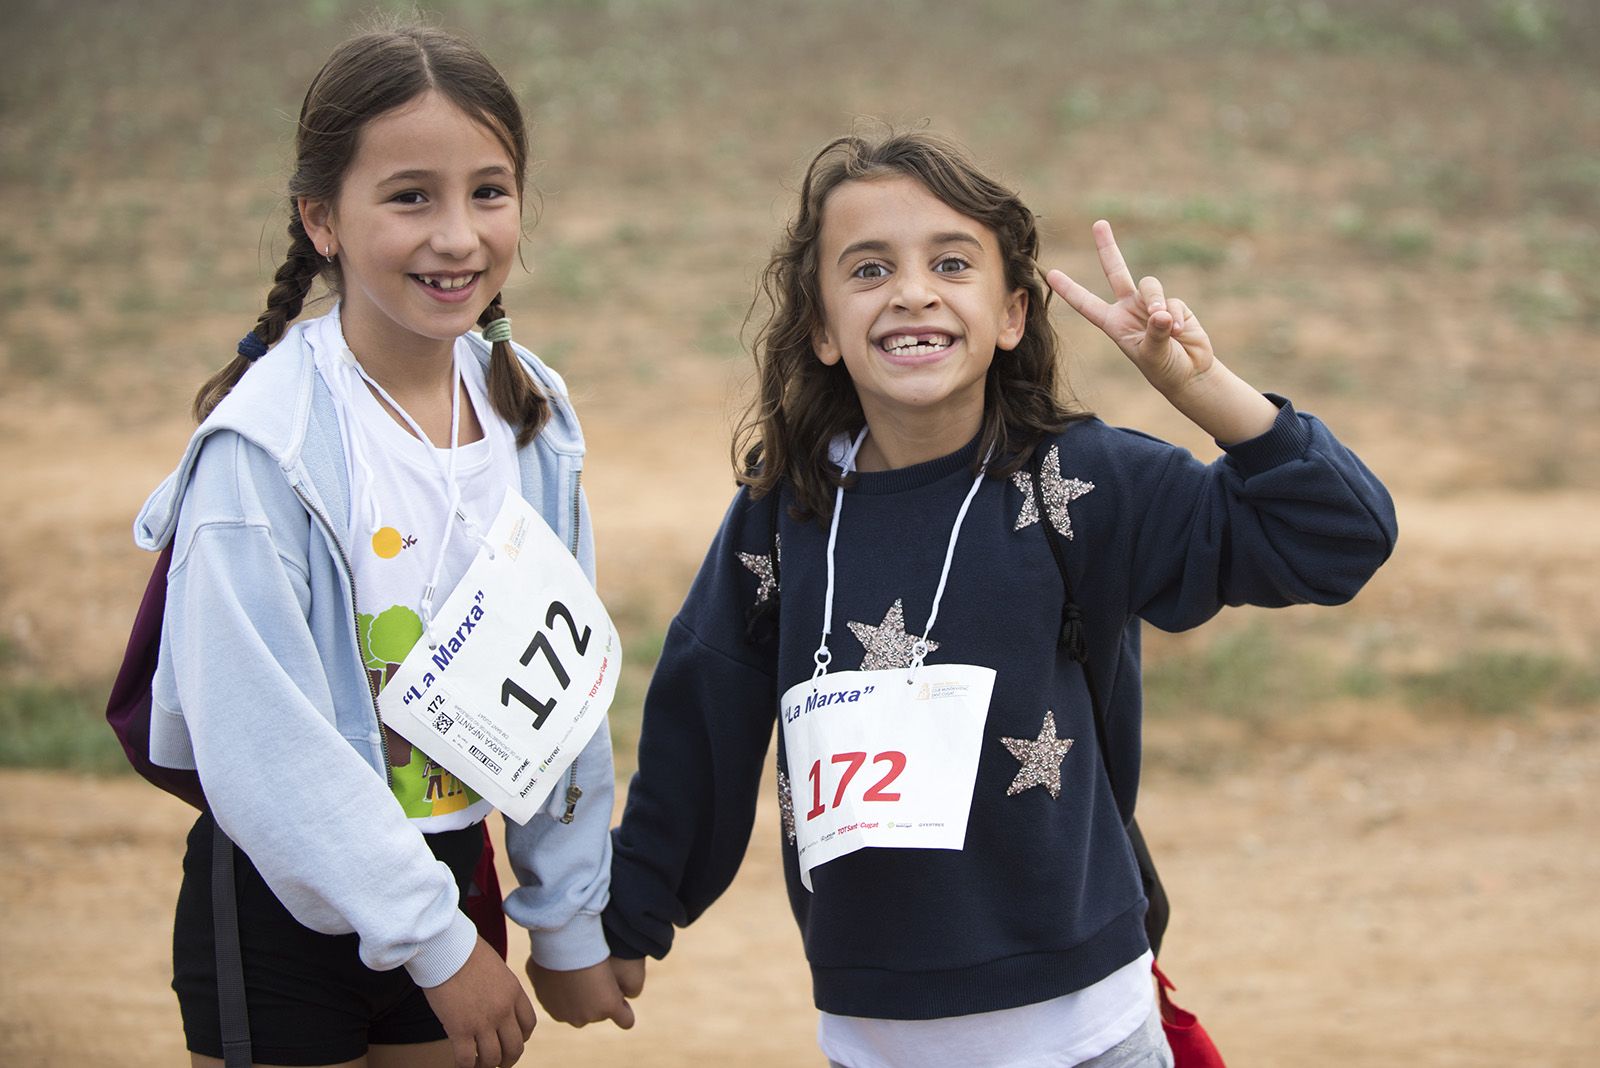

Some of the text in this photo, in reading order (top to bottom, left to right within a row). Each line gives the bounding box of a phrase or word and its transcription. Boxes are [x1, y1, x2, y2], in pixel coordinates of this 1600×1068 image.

[432, 590, 485, 672] Marxa”
[501, 601, 592, 730] 172
[427, 695, 446, 714] 172
[805, 686, 876, 714] Marxa”
[454, 711, 485, 741] INFANTIL
[484, 737, 510, 762] MARXA
[543, 745, 561, 767] ferrer
[806, 750, 907, 821] 172
